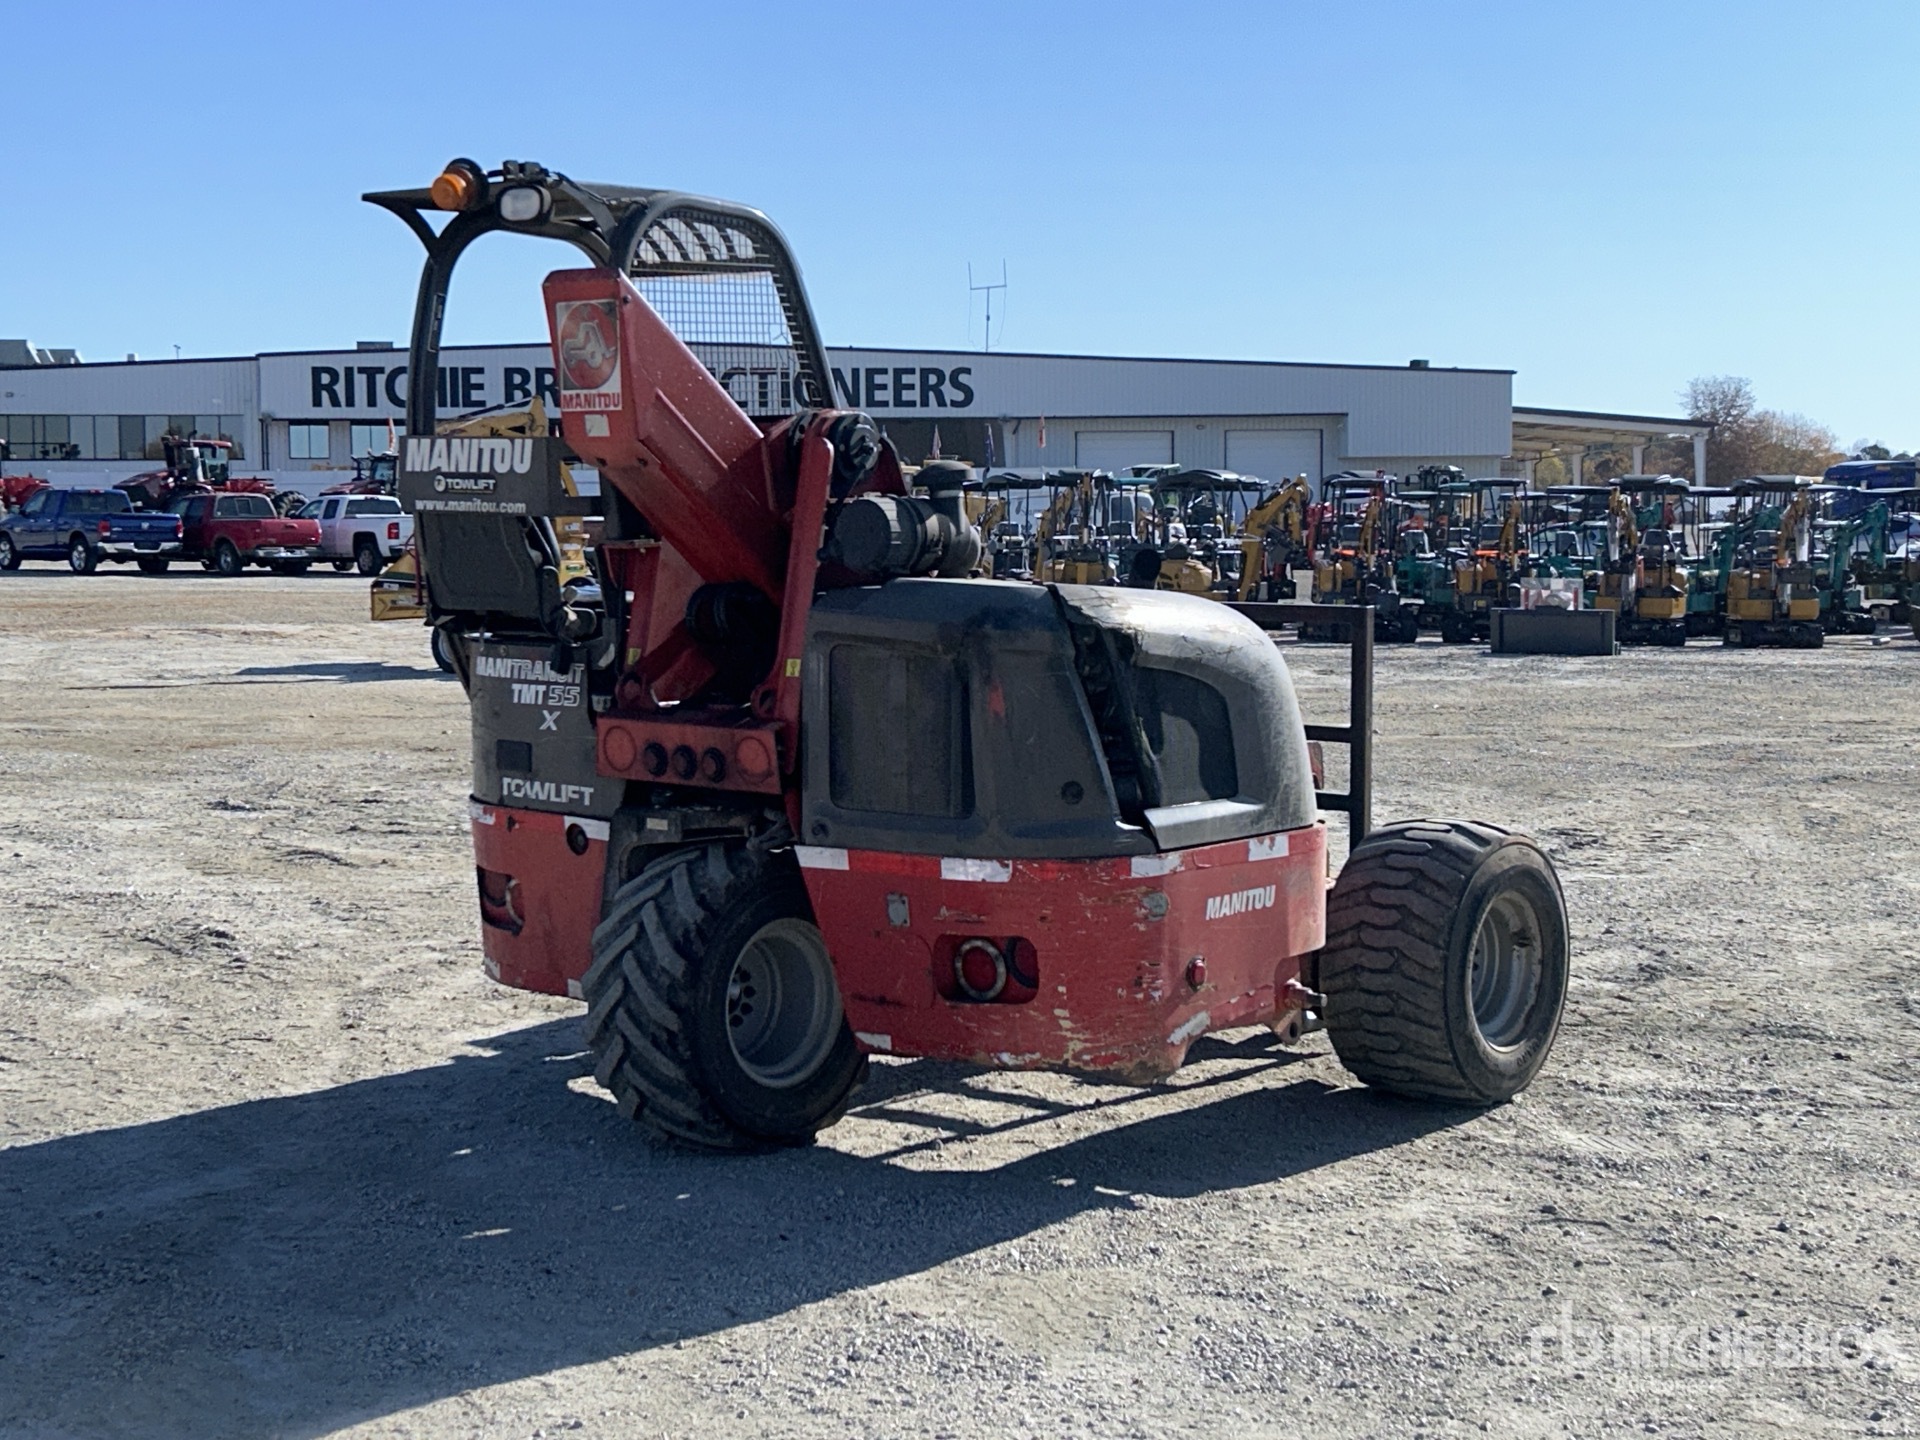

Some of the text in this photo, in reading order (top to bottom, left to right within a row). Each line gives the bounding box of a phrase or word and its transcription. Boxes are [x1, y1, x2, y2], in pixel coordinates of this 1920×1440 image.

[561, 392, 620, 410] MANITOU
[405, 438, 533, 474] MANITOU
[446, 478, 496, 490] TOWLIFT
[415, 499, 526, 514] www.manitou.com
[511, 683, 581, 707] TMT 55
[539, 709, 562, 731] X
[502, 777, 594, 806] TOWLIFT
[1205, 884, 1276, 921] MANITOU
